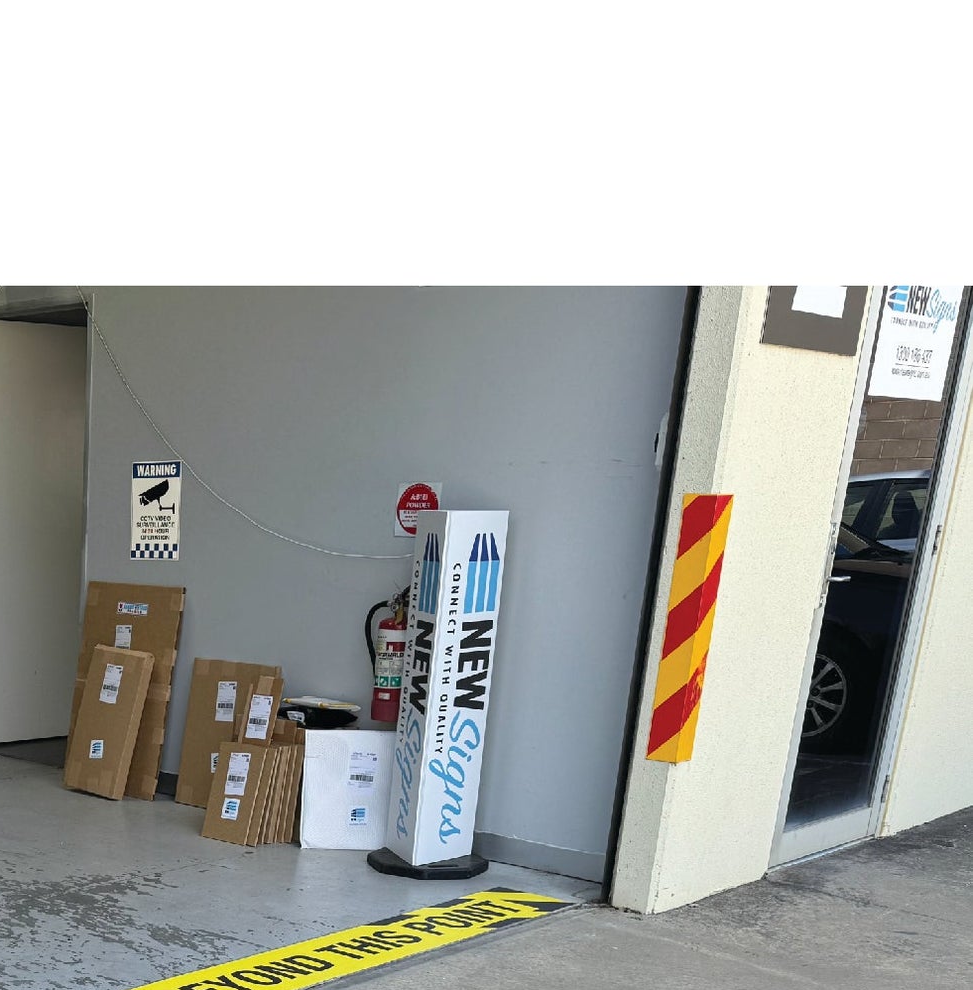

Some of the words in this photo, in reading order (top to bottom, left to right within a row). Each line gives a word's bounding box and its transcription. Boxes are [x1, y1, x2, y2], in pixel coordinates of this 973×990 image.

[906, 286, 932, 316] NEW
[137, 464, 176, 477] WARNING
[410, 560, 421, 630] CONNECT
[447, 562, 461, 635] CONNECT
[405, 640, 413, 677] WITH
[409, 619, 434, 716] NEW
[441, 645, 454, 685] WITH
[453, 619, 494, 711] NEW
[399, 686, 408, 743] QUALITY
[434, 694, 448, 754] QUALITY
[395, 708, 421, 840] Signs
[427, 710, 481, 845] Signs
[314, 930, 420, 960] THIS
[403, 899, 520, 936] POINT
